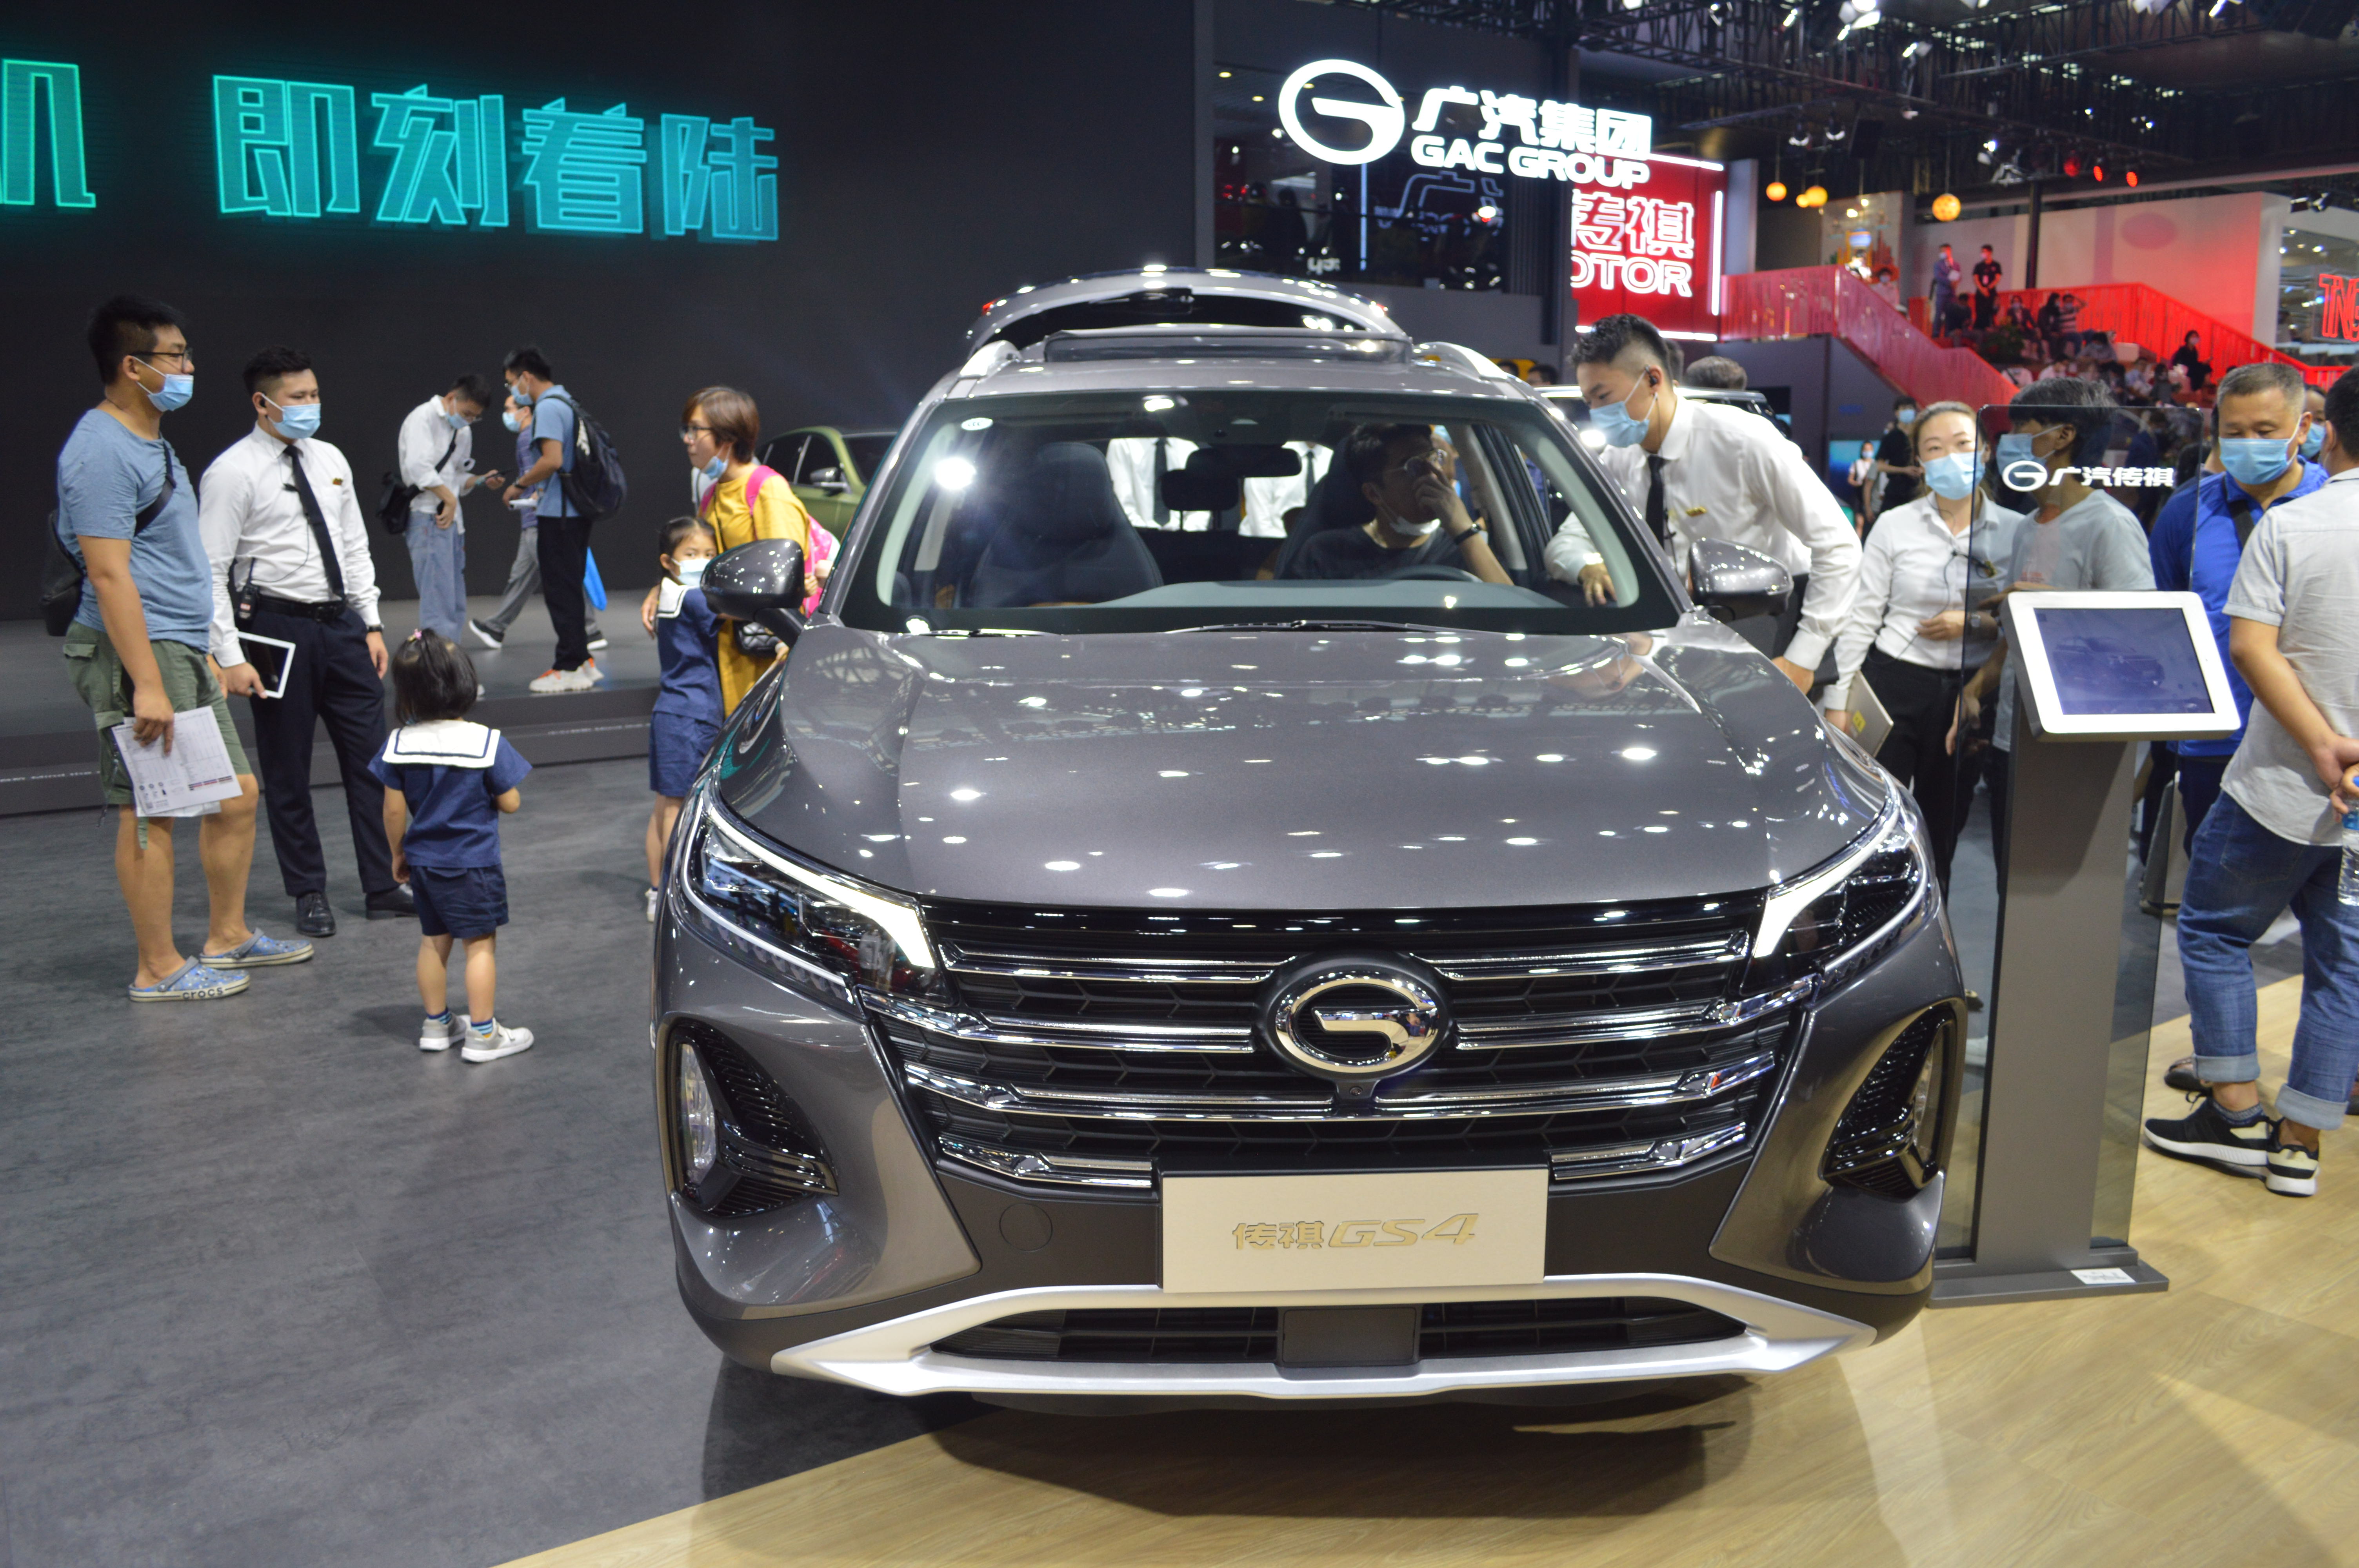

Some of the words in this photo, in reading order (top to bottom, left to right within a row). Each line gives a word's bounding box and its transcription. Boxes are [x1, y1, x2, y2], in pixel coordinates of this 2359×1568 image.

[1411, 85, 1652, 161] 广汽集团
[213, 74, 778, 241] 即刻着陆
[1411, 134, 1504, 174] GAC
[1508, 146, 1650, 190] GROUP
[2049, 466, 2174, 486] 广汽传祺
[182, 987, 224, 1000] crocs
